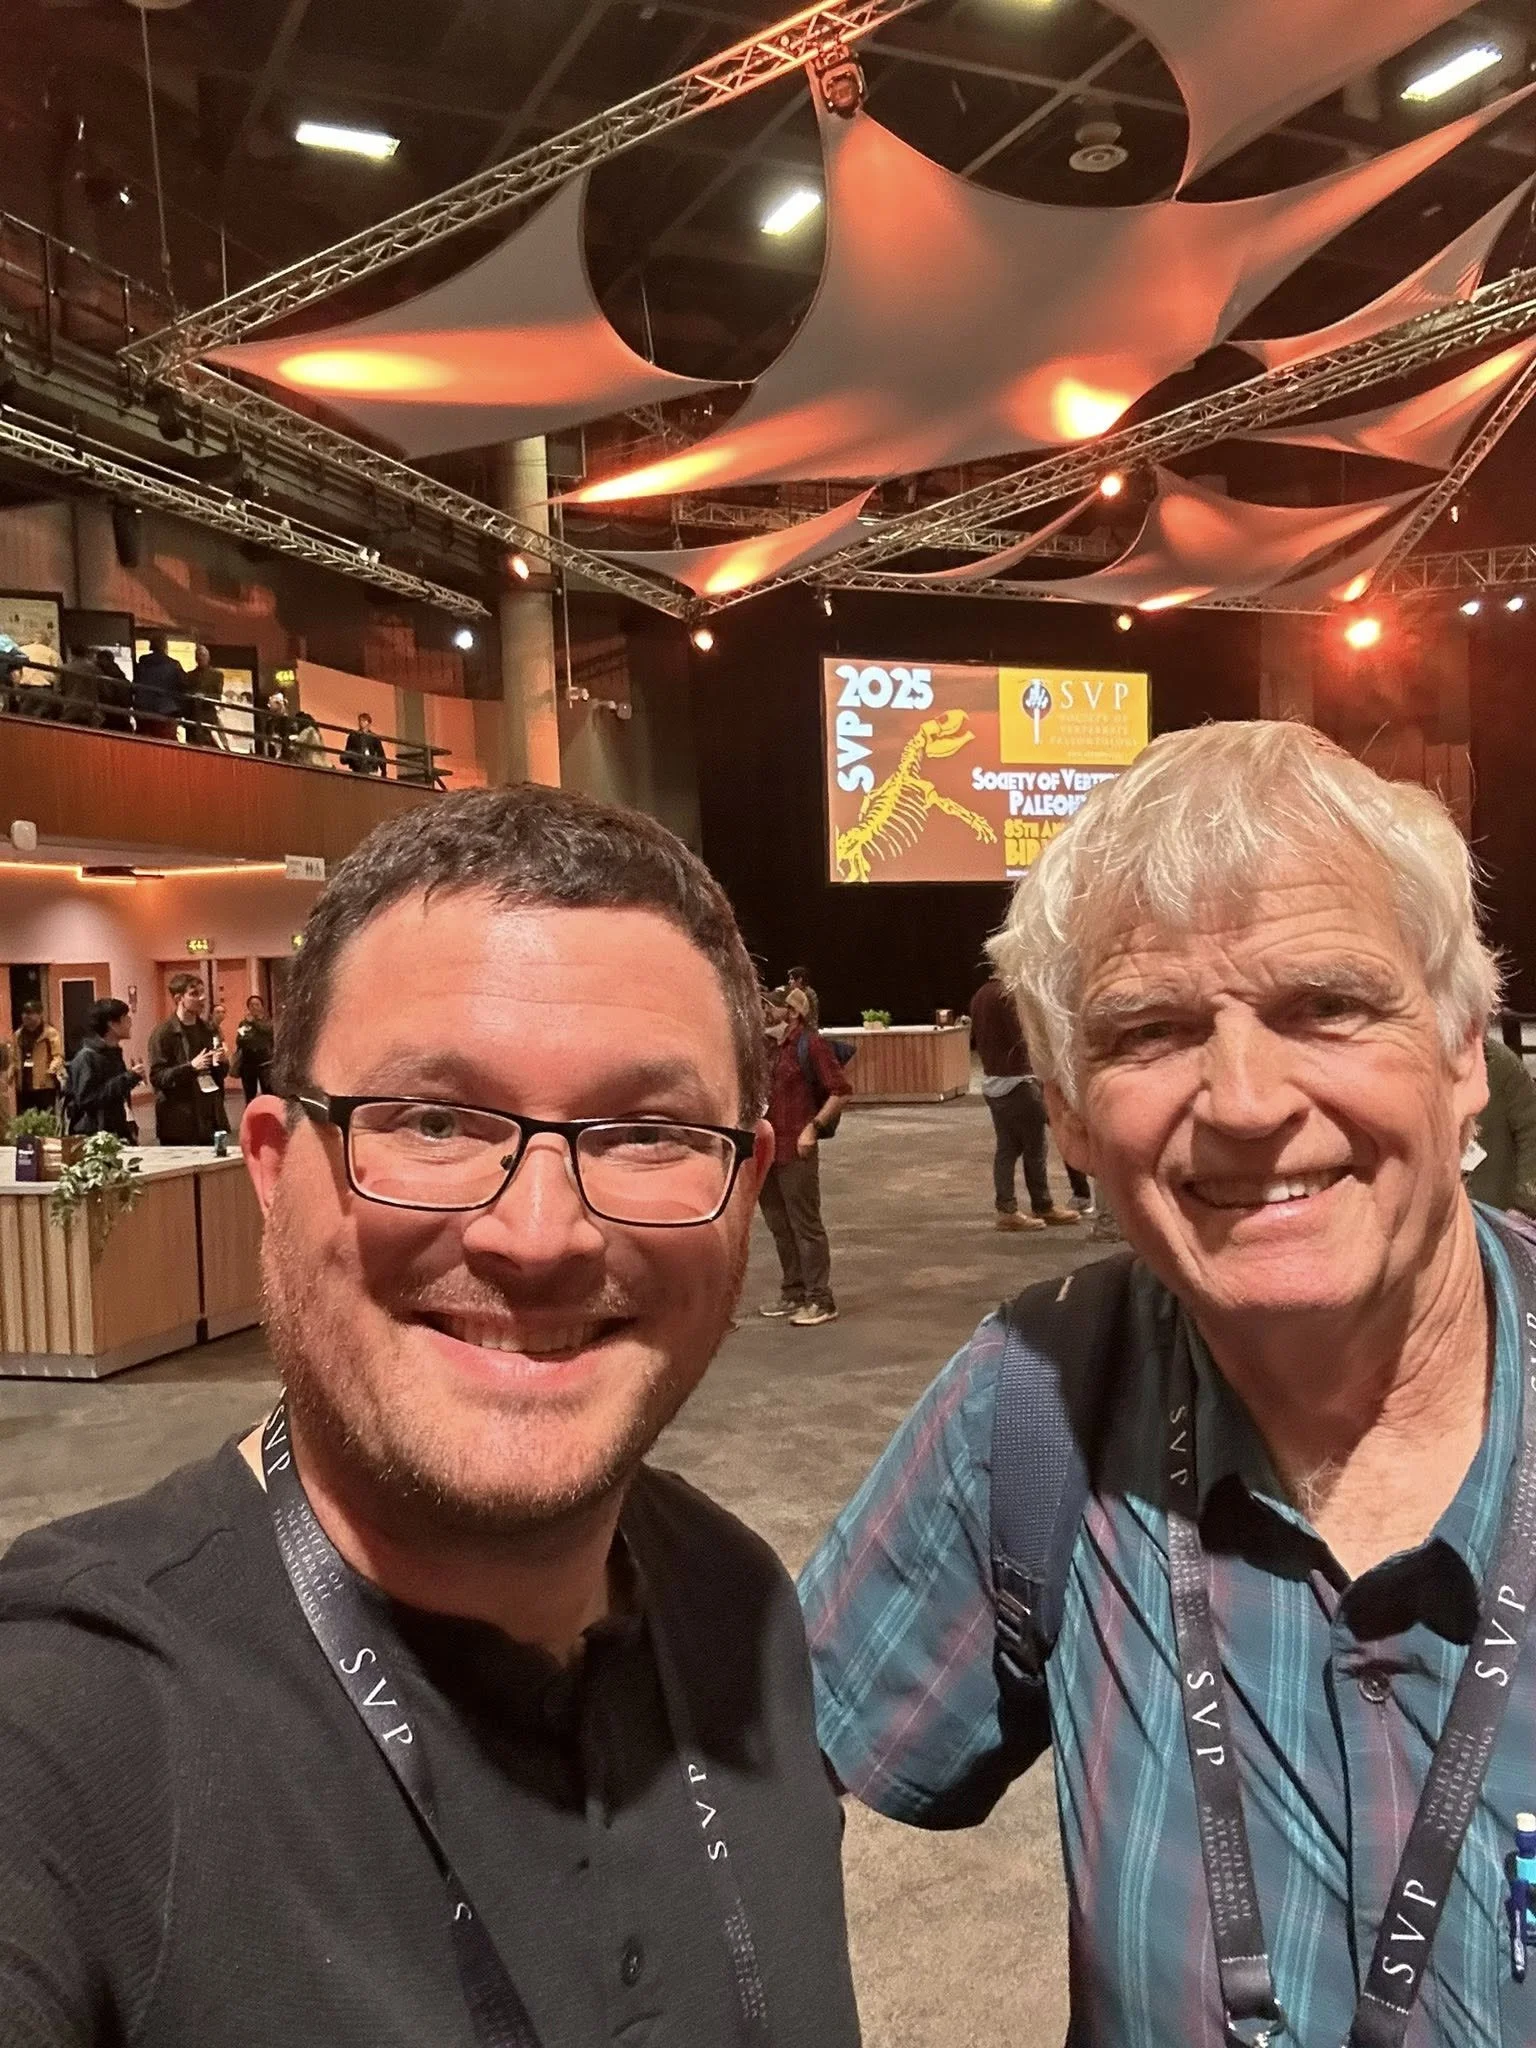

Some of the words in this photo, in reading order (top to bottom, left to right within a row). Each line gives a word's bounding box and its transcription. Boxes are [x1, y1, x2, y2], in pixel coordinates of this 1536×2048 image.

[835, 665, 934, 710] 2025
[1060, 681, 1129, 710] SVP
[836, 710, 874, 793] SVP
[972, 767, 1036, 790] SOCIETY
[1037, 772, 1060, 790] OF
[265, 1404, 291, 1476] SVP
[1169, 1406, 1188, 1485] SVP
[1474, 1584, 1526, 1687] SVP
[339, 1647, 413, 1744] SVP
[1187, 1670, 1225, 1766] SVP
[689, 1763, 727, 1860] SVP
[1382, 1880, 1436, 1984] SVP
